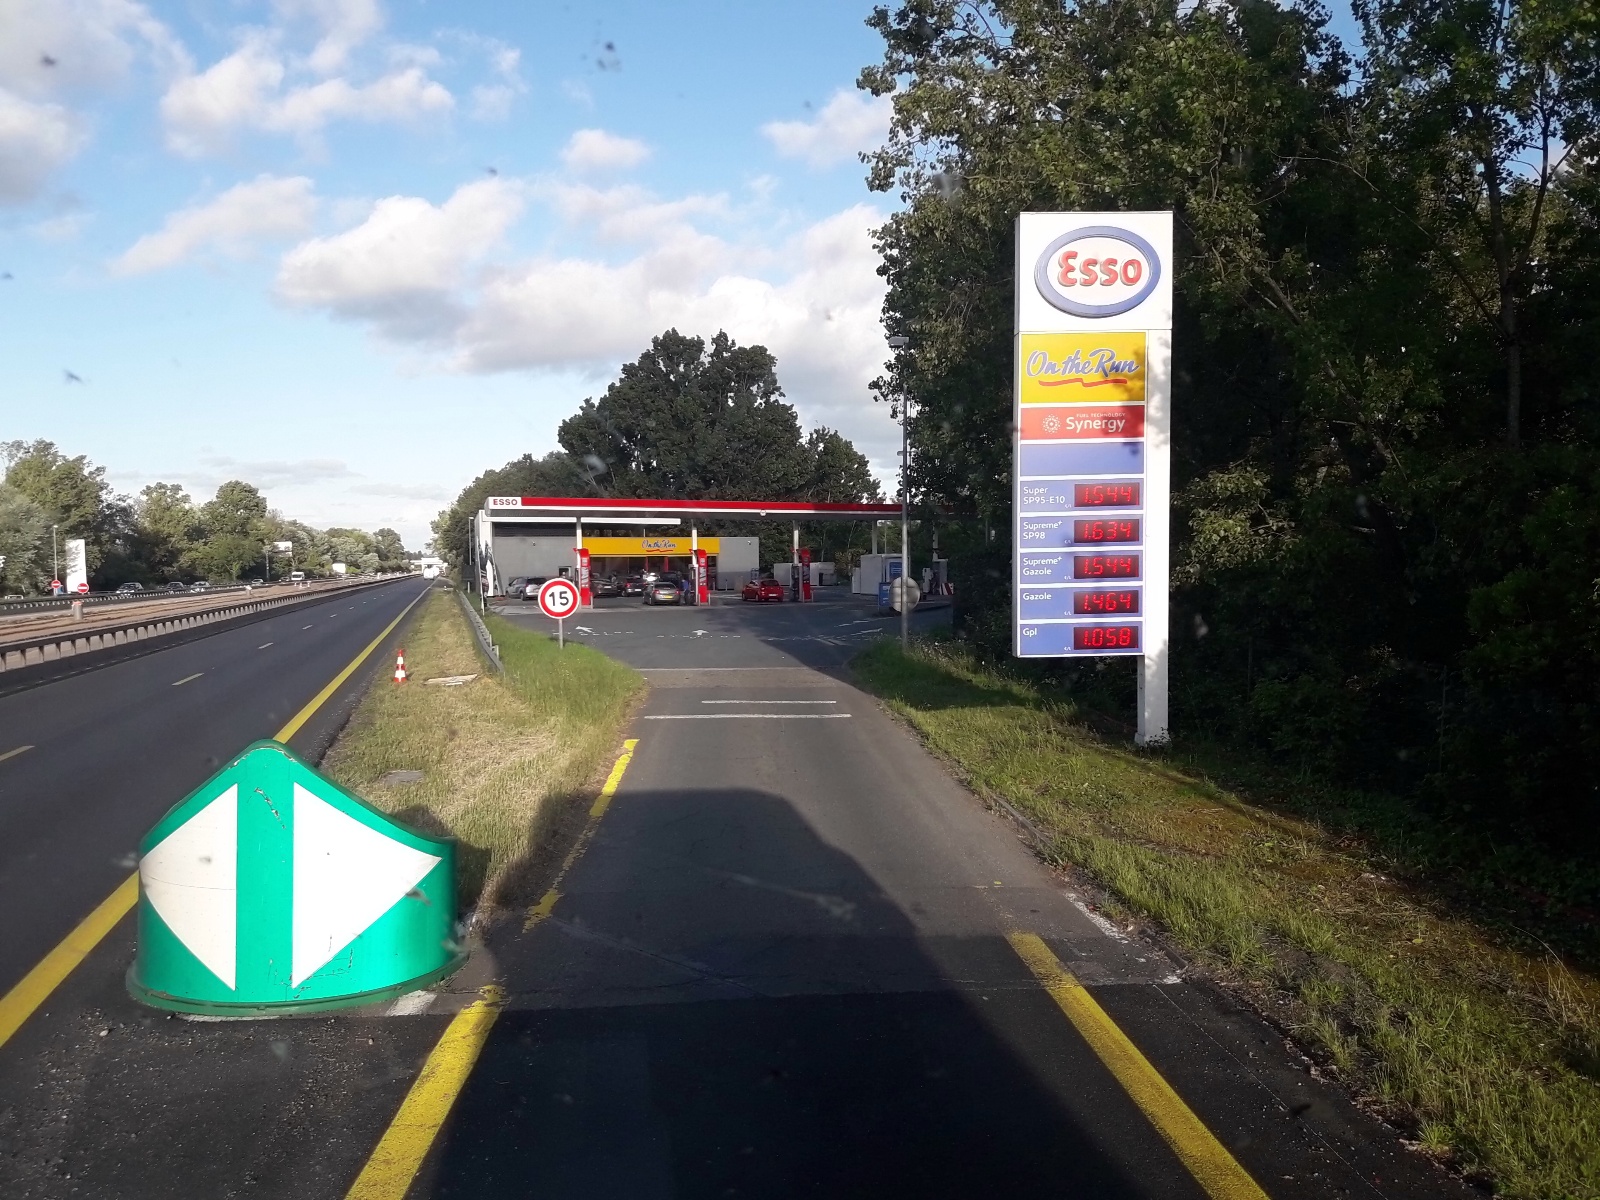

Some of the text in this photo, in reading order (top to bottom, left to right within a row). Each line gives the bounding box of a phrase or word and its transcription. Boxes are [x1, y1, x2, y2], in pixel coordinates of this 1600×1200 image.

[1026, 348, 1139, 378] On the Run
[1066, 416, 1126, 434] Synergy
[1023, 486, 1048, 495] Super
[1085, 486, 1132, 504] 1.544
[492, 498, 518, 506] ESSO
[1023, 496, 1065, 505] SP95-E10
[1023, 531, 1046, 540] SP98
[1084, 521, 1132, 540] 1.634
[1023, 567, 1052, 576] Gazole
[1084, 557, 1132, 575] 1.544
[549, 591, 569, 607] 15
[1023, 592, 1052, 601] Gazole
[1084, 592, 1132, 611] 1.464
[1023, 628, 1038, 638] Gpl
[1084, 628, 1132, 646] 1.058
